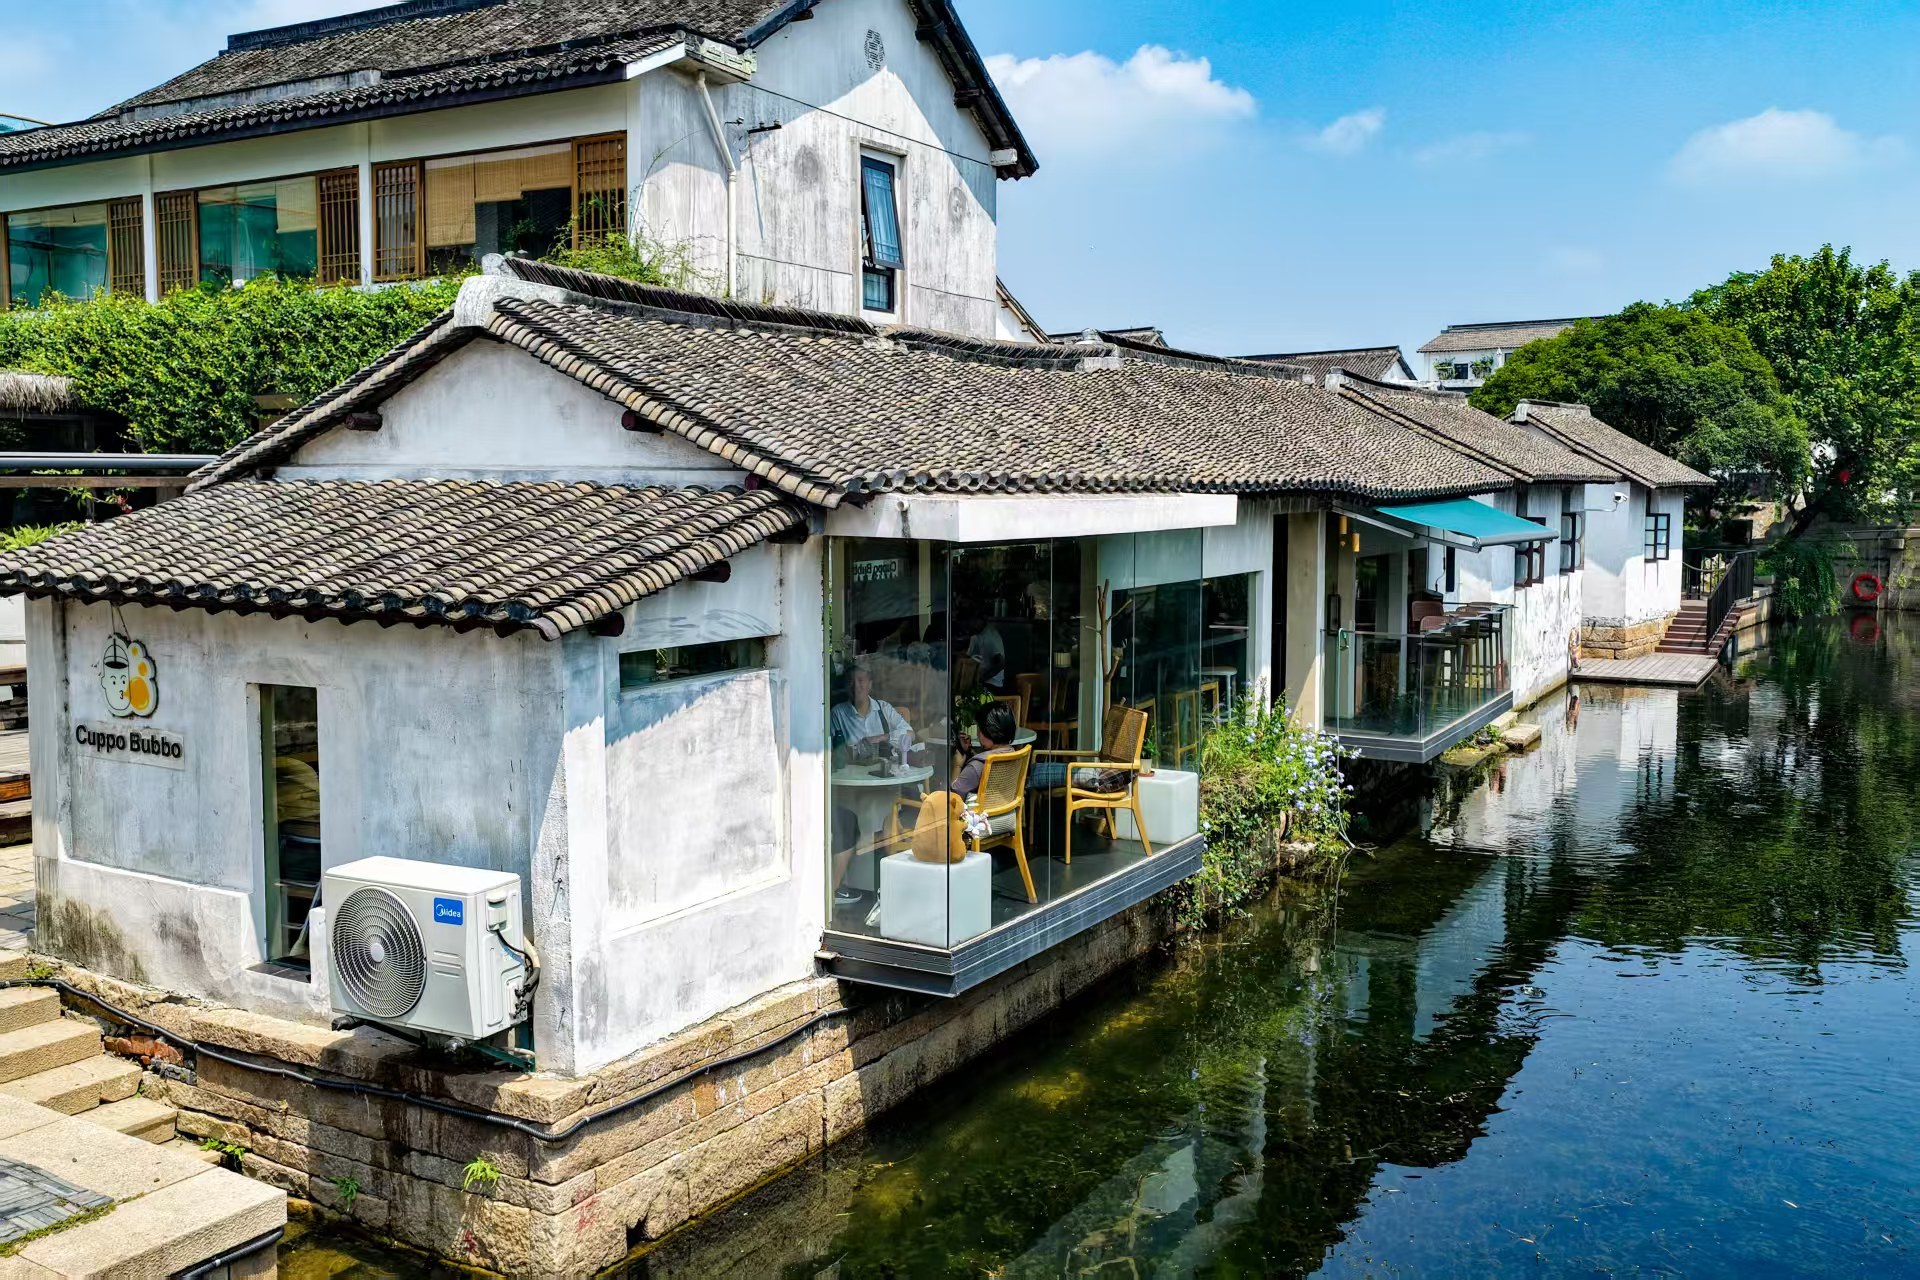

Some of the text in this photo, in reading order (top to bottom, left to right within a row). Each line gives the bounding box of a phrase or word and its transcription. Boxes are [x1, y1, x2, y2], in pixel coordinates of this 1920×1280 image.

[75, 724, 182, 758] Cuppo Bubbo
[435, 903, 462, 918] Midea
